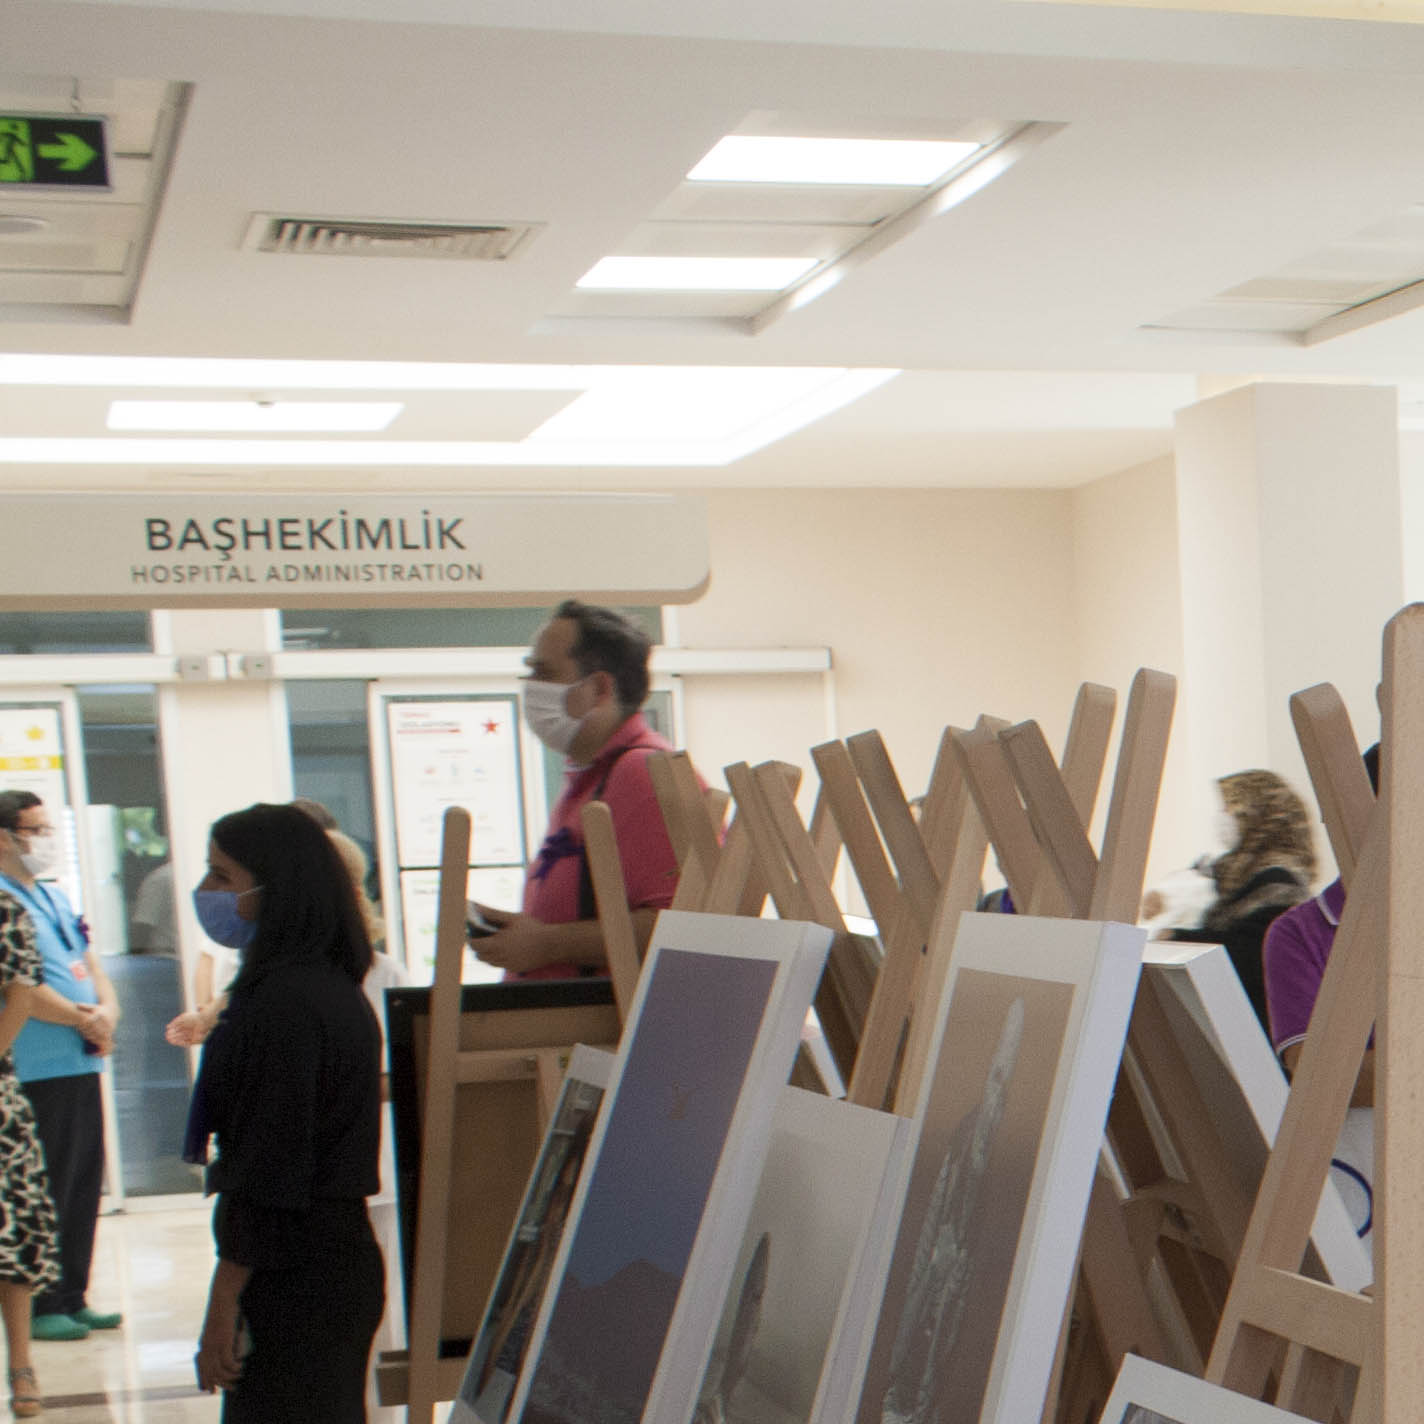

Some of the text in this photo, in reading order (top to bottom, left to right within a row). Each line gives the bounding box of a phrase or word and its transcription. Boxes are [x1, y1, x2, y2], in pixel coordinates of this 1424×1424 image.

[145, 509, 467, 561] BAŞHEKİMLİK
[131, 563, 484, 583] HOSPITAL ADMINISTRATION
